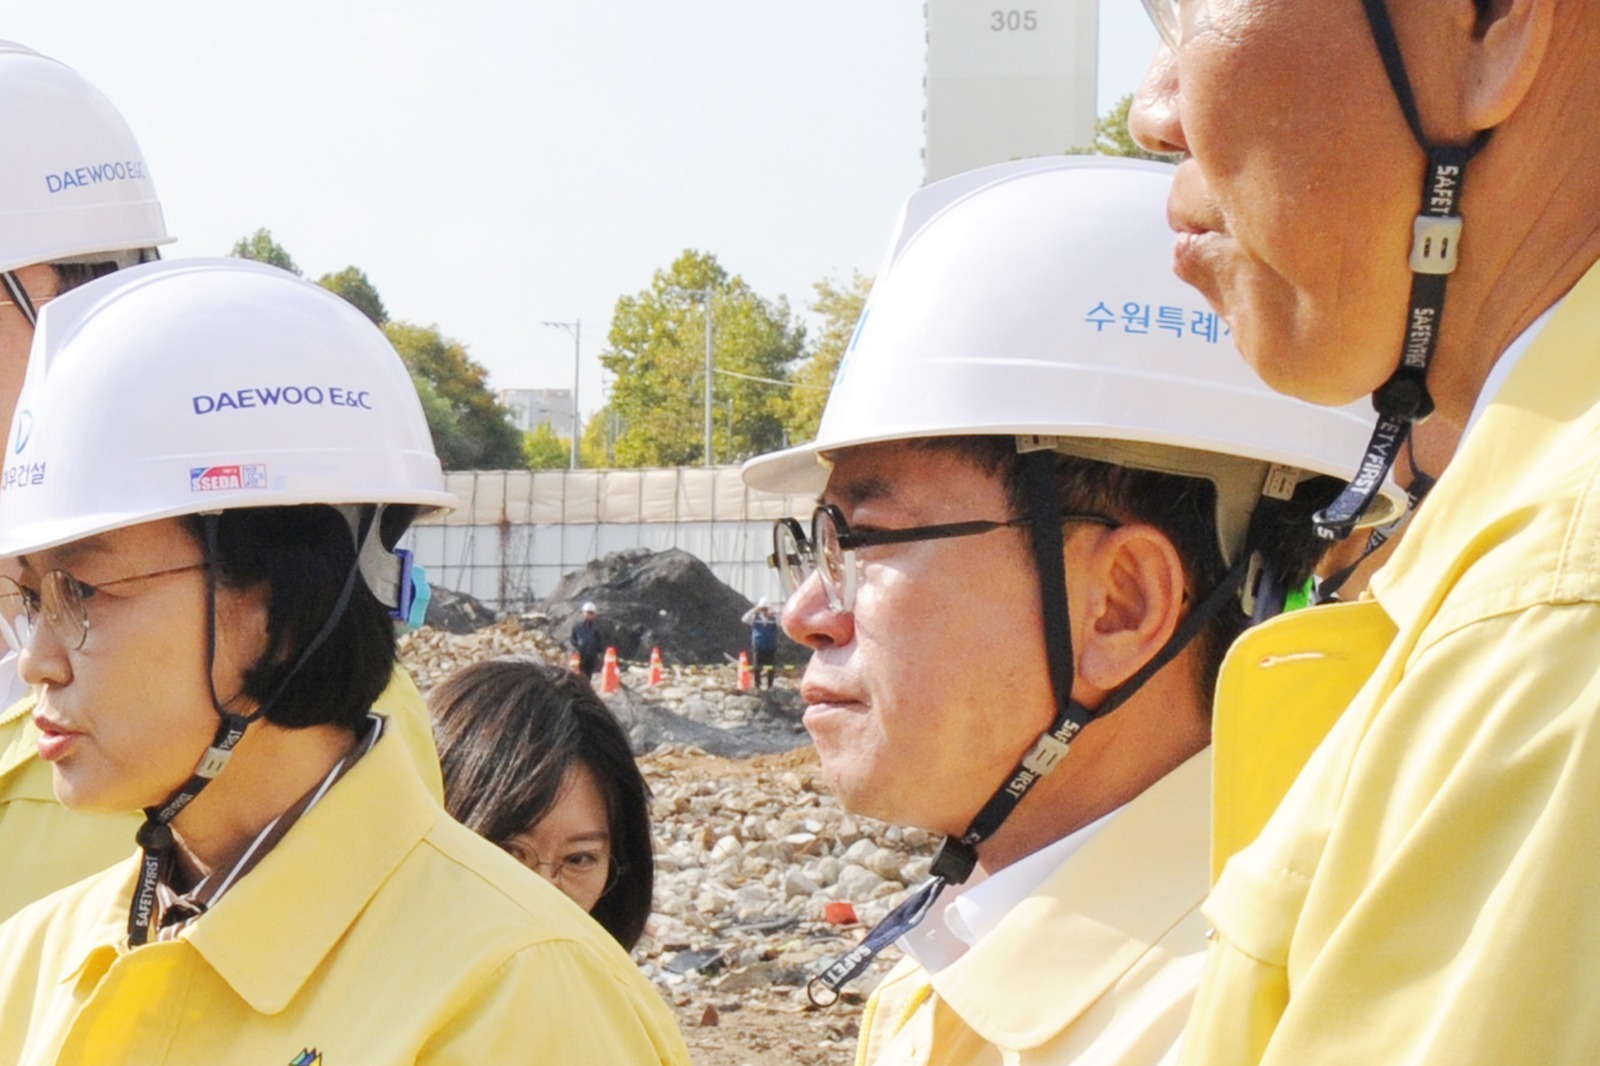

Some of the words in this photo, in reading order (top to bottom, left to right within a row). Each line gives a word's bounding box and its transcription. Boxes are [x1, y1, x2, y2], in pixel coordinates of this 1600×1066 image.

[990, 9, 1038, 31] 305
[45, 161, 126, 193] DAEWOO
[1429, 164, 1459, 217] SAFET
[1084, 301, 1231, 344] 수원특례
[192, 385, 324, 415] DAEWOO
[328, 386, 373, 411] E&C
[135, 855, 159, 928] SAFETYFIRST
